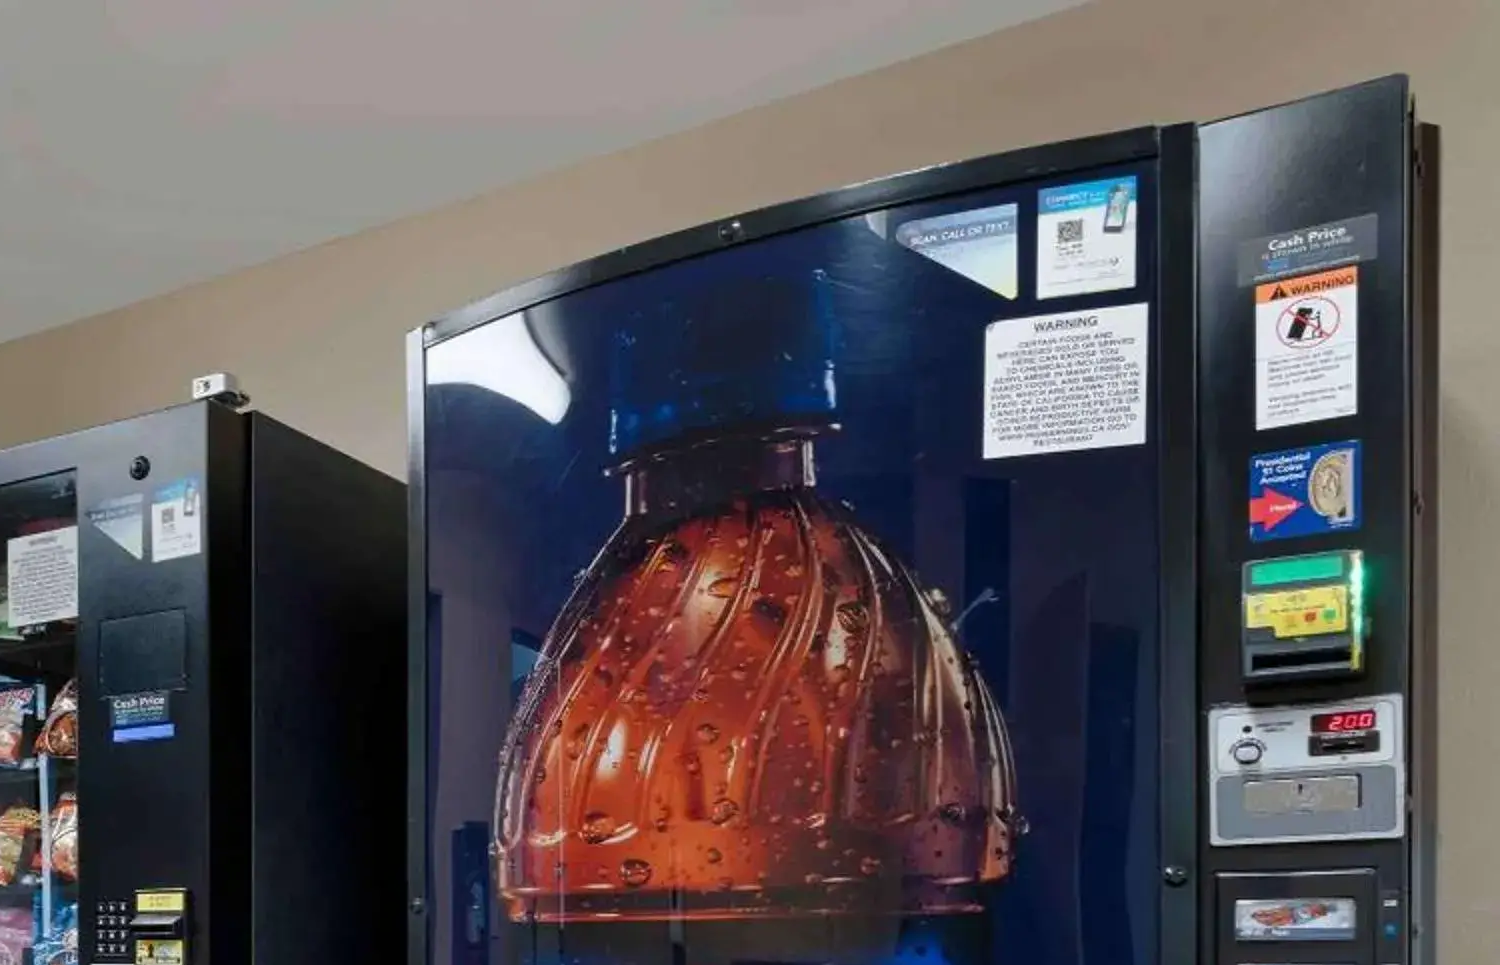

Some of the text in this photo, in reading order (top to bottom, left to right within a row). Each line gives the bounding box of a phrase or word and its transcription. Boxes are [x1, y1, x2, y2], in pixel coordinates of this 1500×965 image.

[1268, 226, 1346, 251] Cash Price
[1291, 276, 1352, 294] WARNING
[1033, 315, 1098, 332] WARNING
[114, 698, 137, 708] Cash
